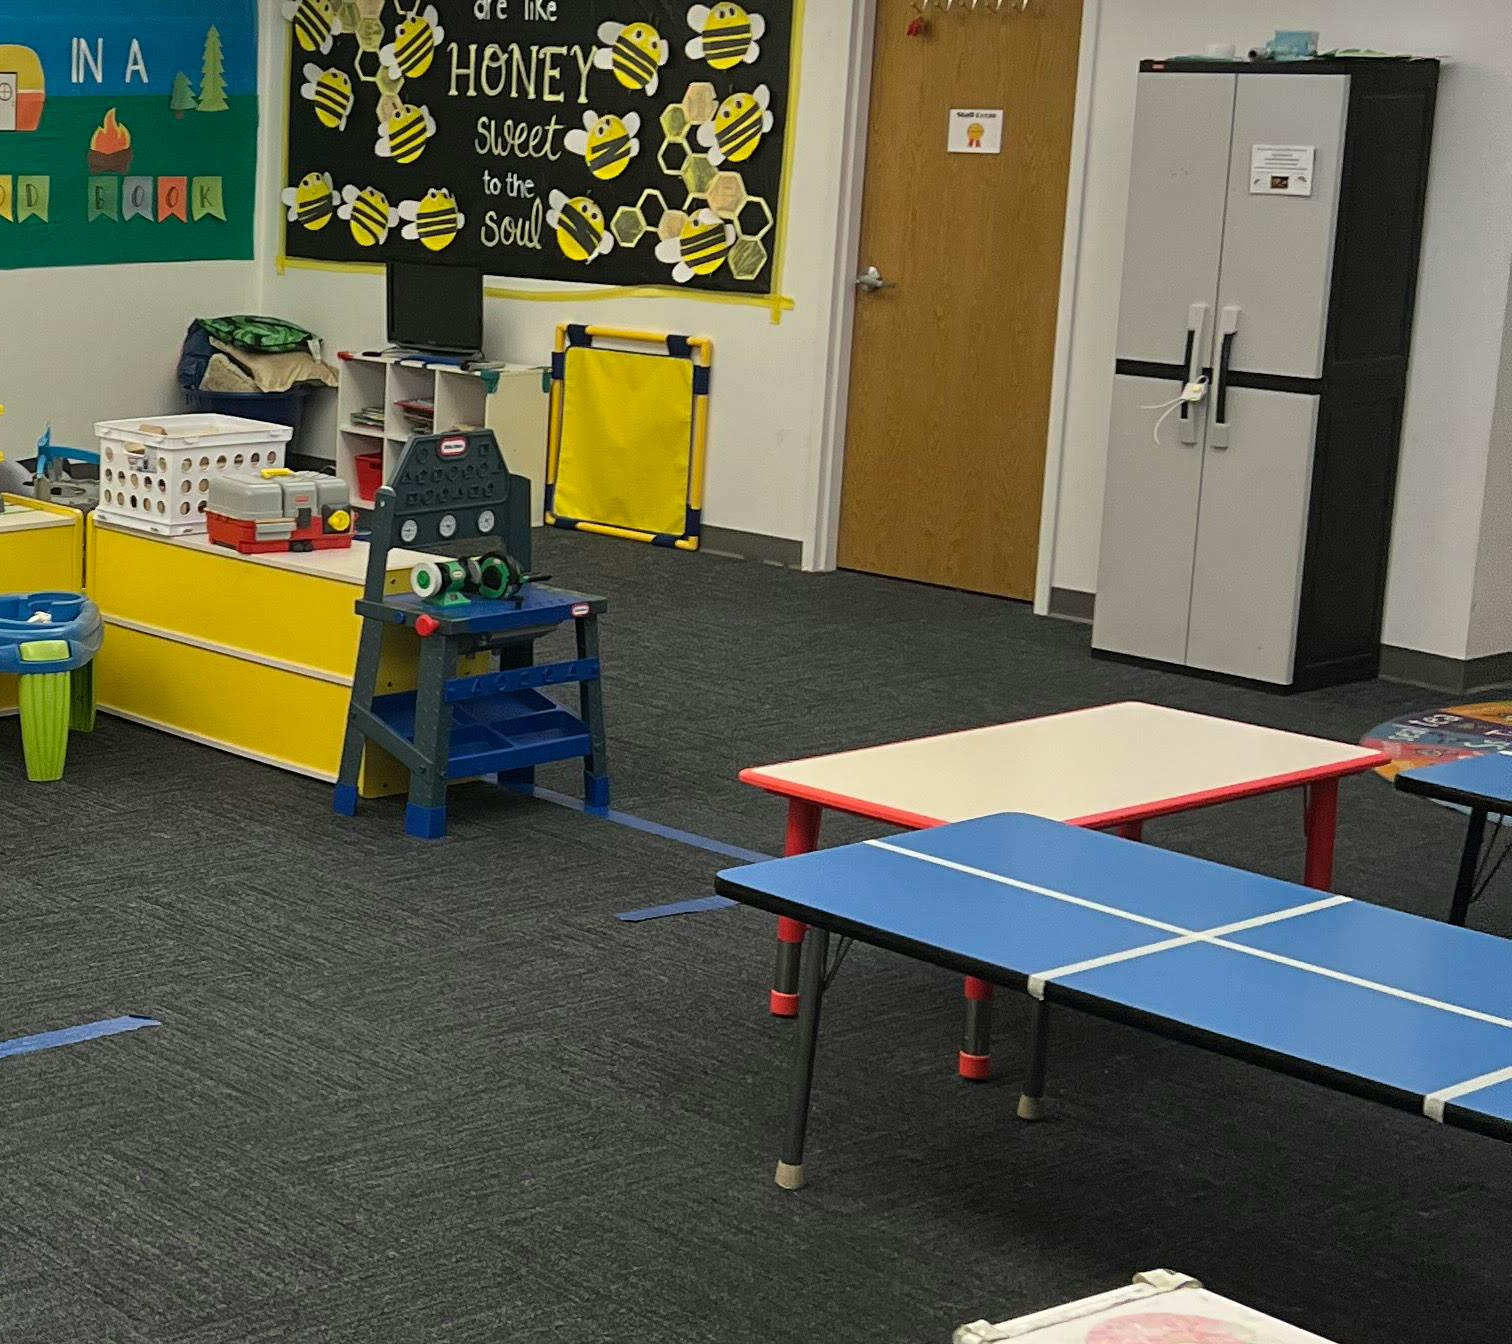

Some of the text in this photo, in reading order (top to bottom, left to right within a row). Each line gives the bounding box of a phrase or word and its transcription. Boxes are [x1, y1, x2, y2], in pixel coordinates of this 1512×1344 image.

[70, 37, 149, 83] IN A
[446, 42, 600, 104] HONEY
[94, 182, 215, 209] BOOK
[482, 169, 535, 198] to the
